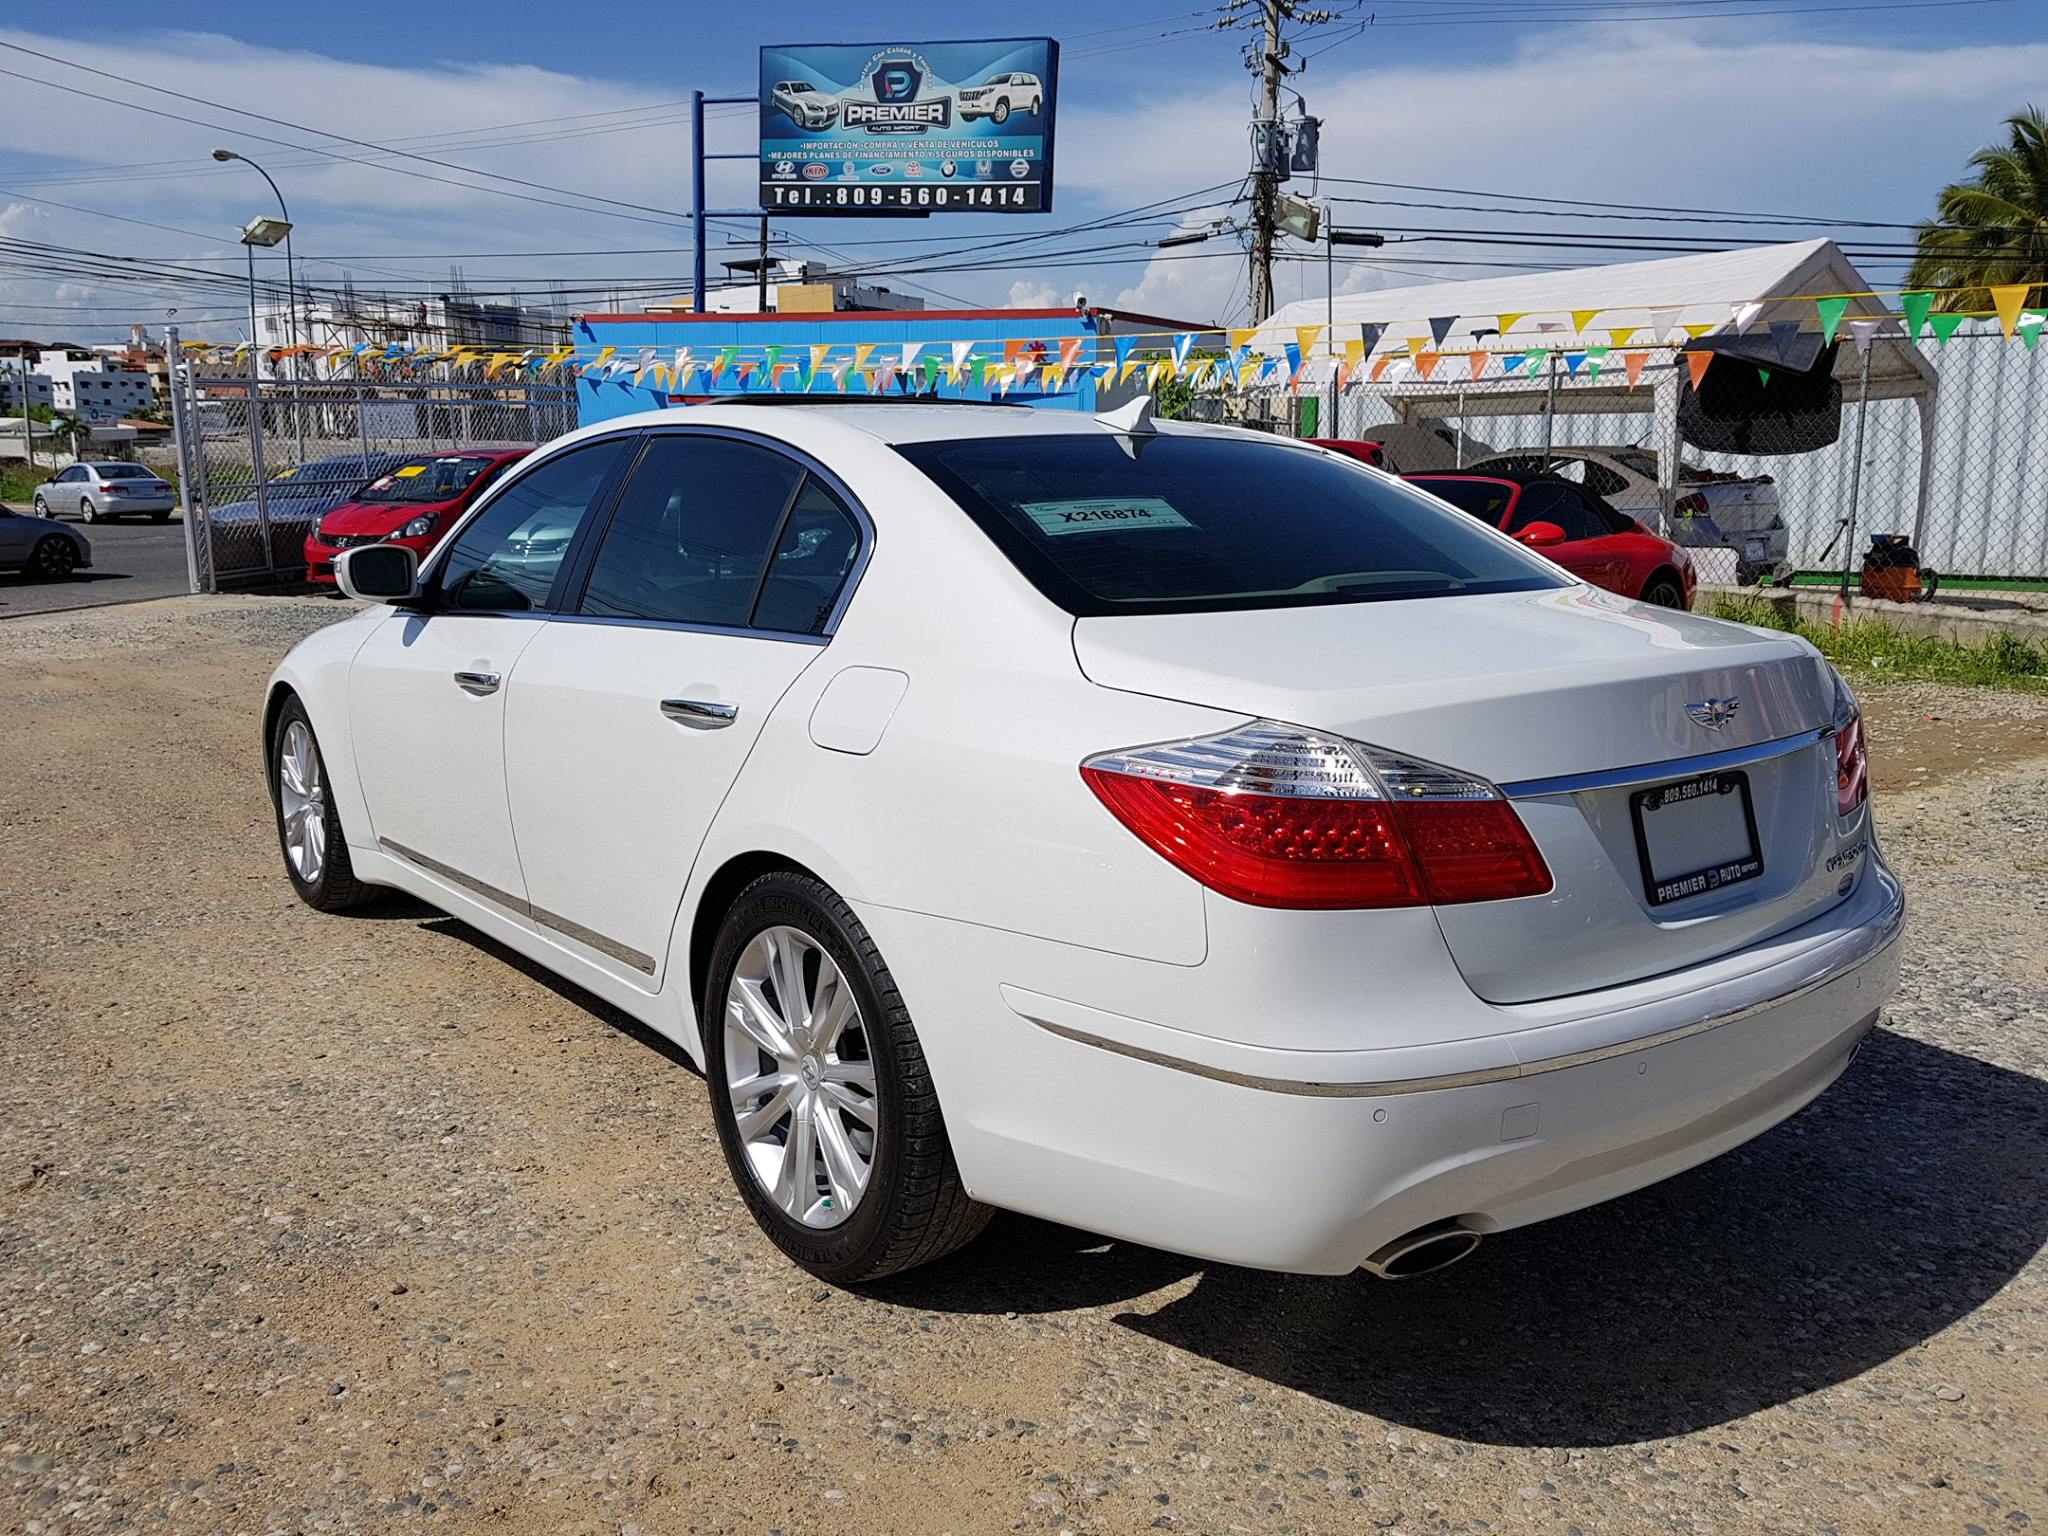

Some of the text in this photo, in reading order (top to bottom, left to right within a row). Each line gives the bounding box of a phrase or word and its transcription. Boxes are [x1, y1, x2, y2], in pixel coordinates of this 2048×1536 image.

[847, 103, 944, 123] PREMIER
[863, 141, 898, 149] COMPRA
[908, 141, 935, 149] VENTA
[937, 141, 949, 149] DE
[770, 151, 808, 159] MEJORES
[809, 151, 841, 159] PLANES
[842, 151, 853, 159] DE
[935, 150, 975, 158] SEGUROS
[977, 149, 1035, 157] DISPONIBLES
[1058, 508, 1153, 523] X216874
[1664, 778, 1718, 803] 809.560.1414
[1657, 875, 1706, 902] PREMIER
[1720, 864, 1741, 882] AUTO
